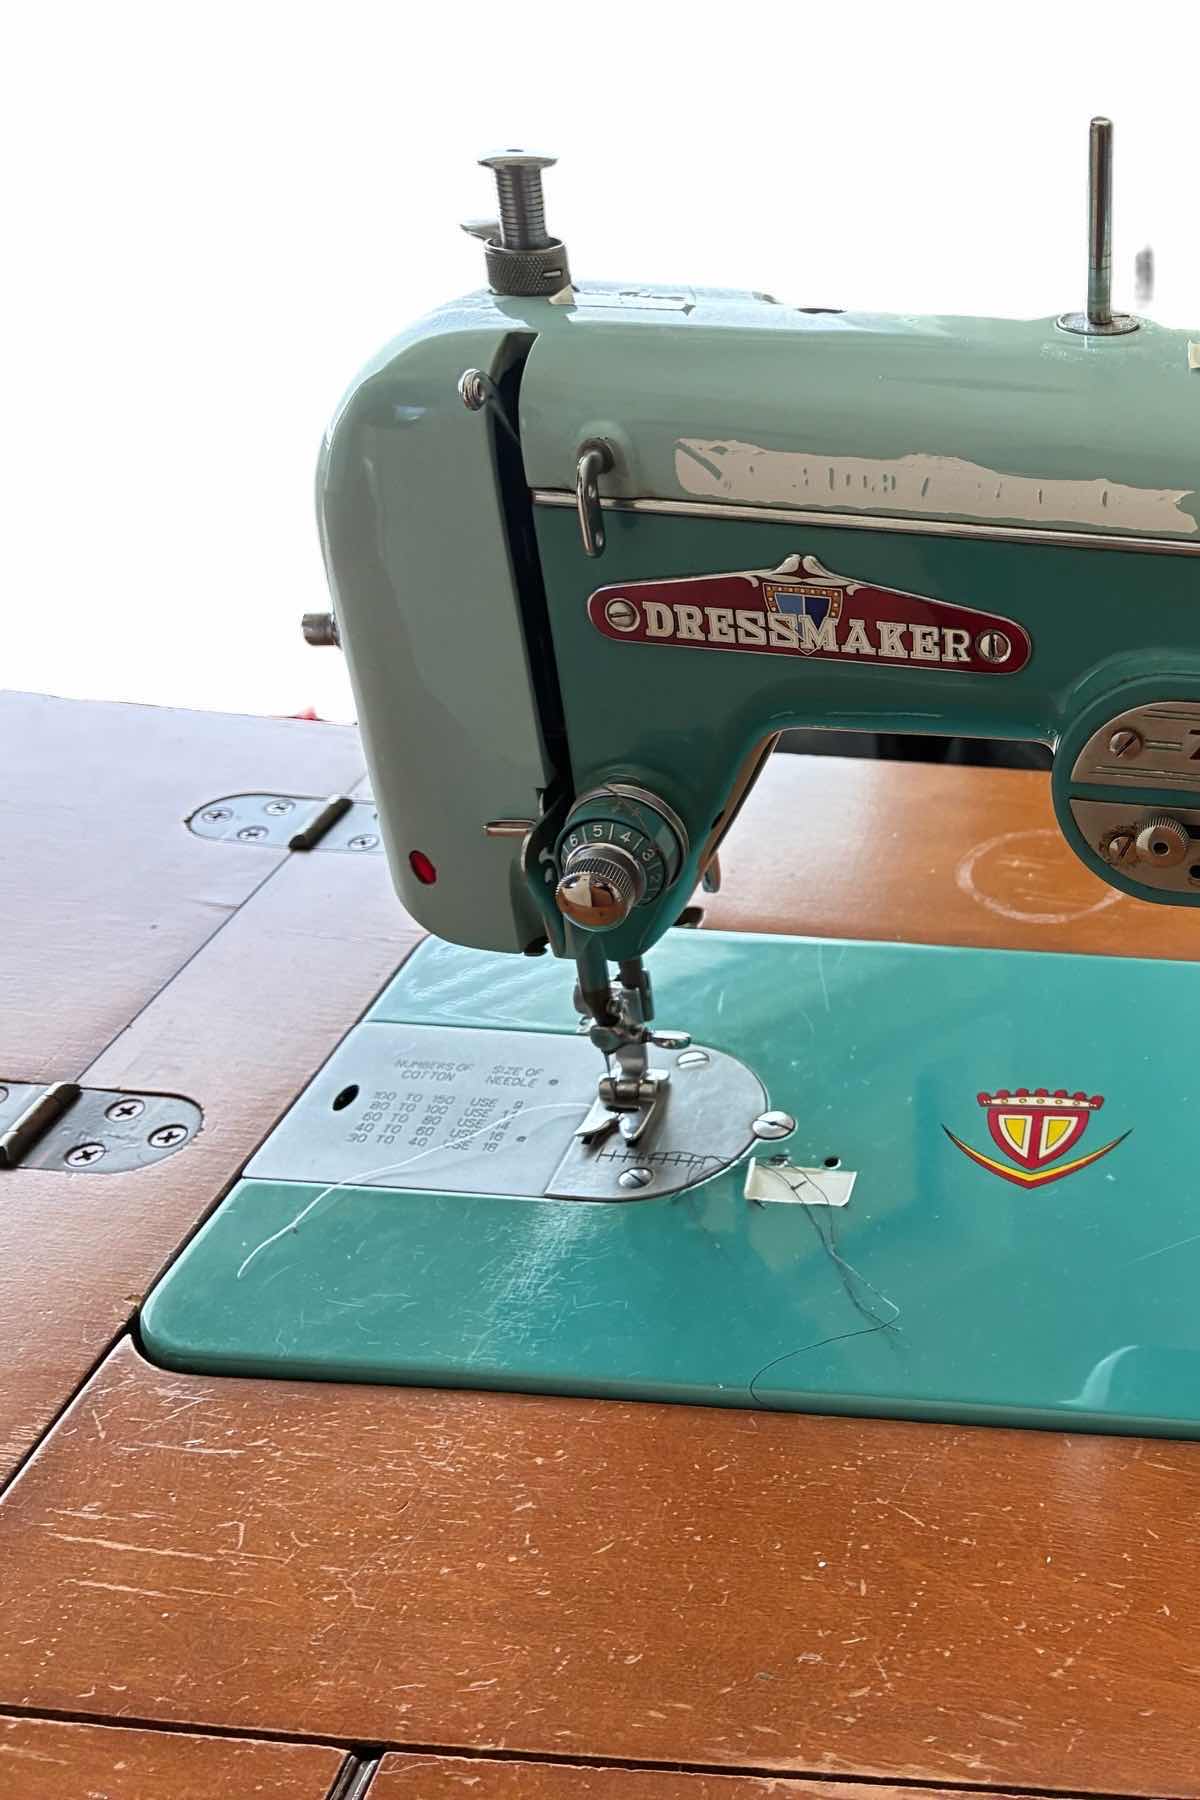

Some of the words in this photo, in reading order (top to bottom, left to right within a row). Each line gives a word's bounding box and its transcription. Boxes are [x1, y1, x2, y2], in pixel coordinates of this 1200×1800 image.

[643, 601, 972, 663] DRESSMAKER
[592, 824, 605, 838] 5
[619, 831, 632, 844] 4
[401, 1070, 456, 1081] COTTON
[485, 1076, 539, 1088] NEEDLE
[405, 1093, 423, 1102] TO
[470, 1097, 498, 1108] USE
[399, 1103, 416, 1112] TO
[424, 1104, 448, 1115] 100
[464, 1108, 492, 1118] USE
[353, 1122, 375, 1133] 40
[383, 1124, 402, 1134] TO
[390, 1113, 409, 1123] TO
[457, 1118, 486, 1129] USE
[375, 1135, 396, 1145] TO
[408, 1137, 429, 1147] 40
